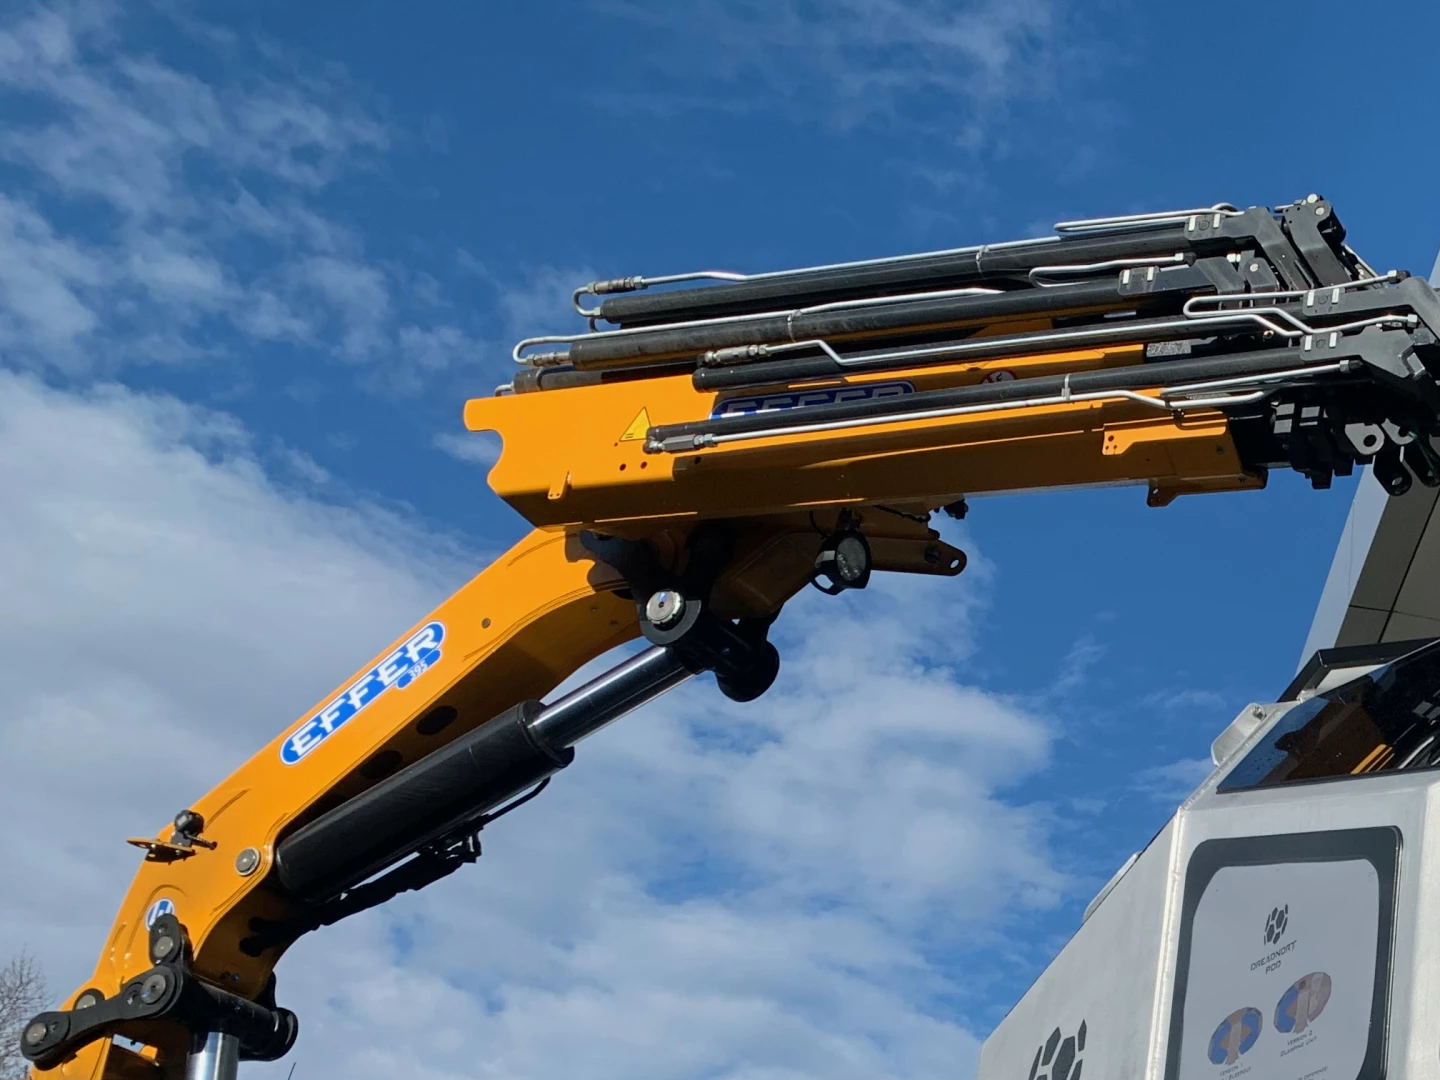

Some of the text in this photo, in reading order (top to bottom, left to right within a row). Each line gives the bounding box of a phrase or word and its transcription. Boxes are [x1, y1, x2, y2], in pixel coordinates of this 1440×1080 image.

[408, 660, 429, 680] 395
[289, 627, 439, 757] EFFER
[1250, 939, 1298, 972] DREADNORT
[1265, 959, 1282, 976] POD
